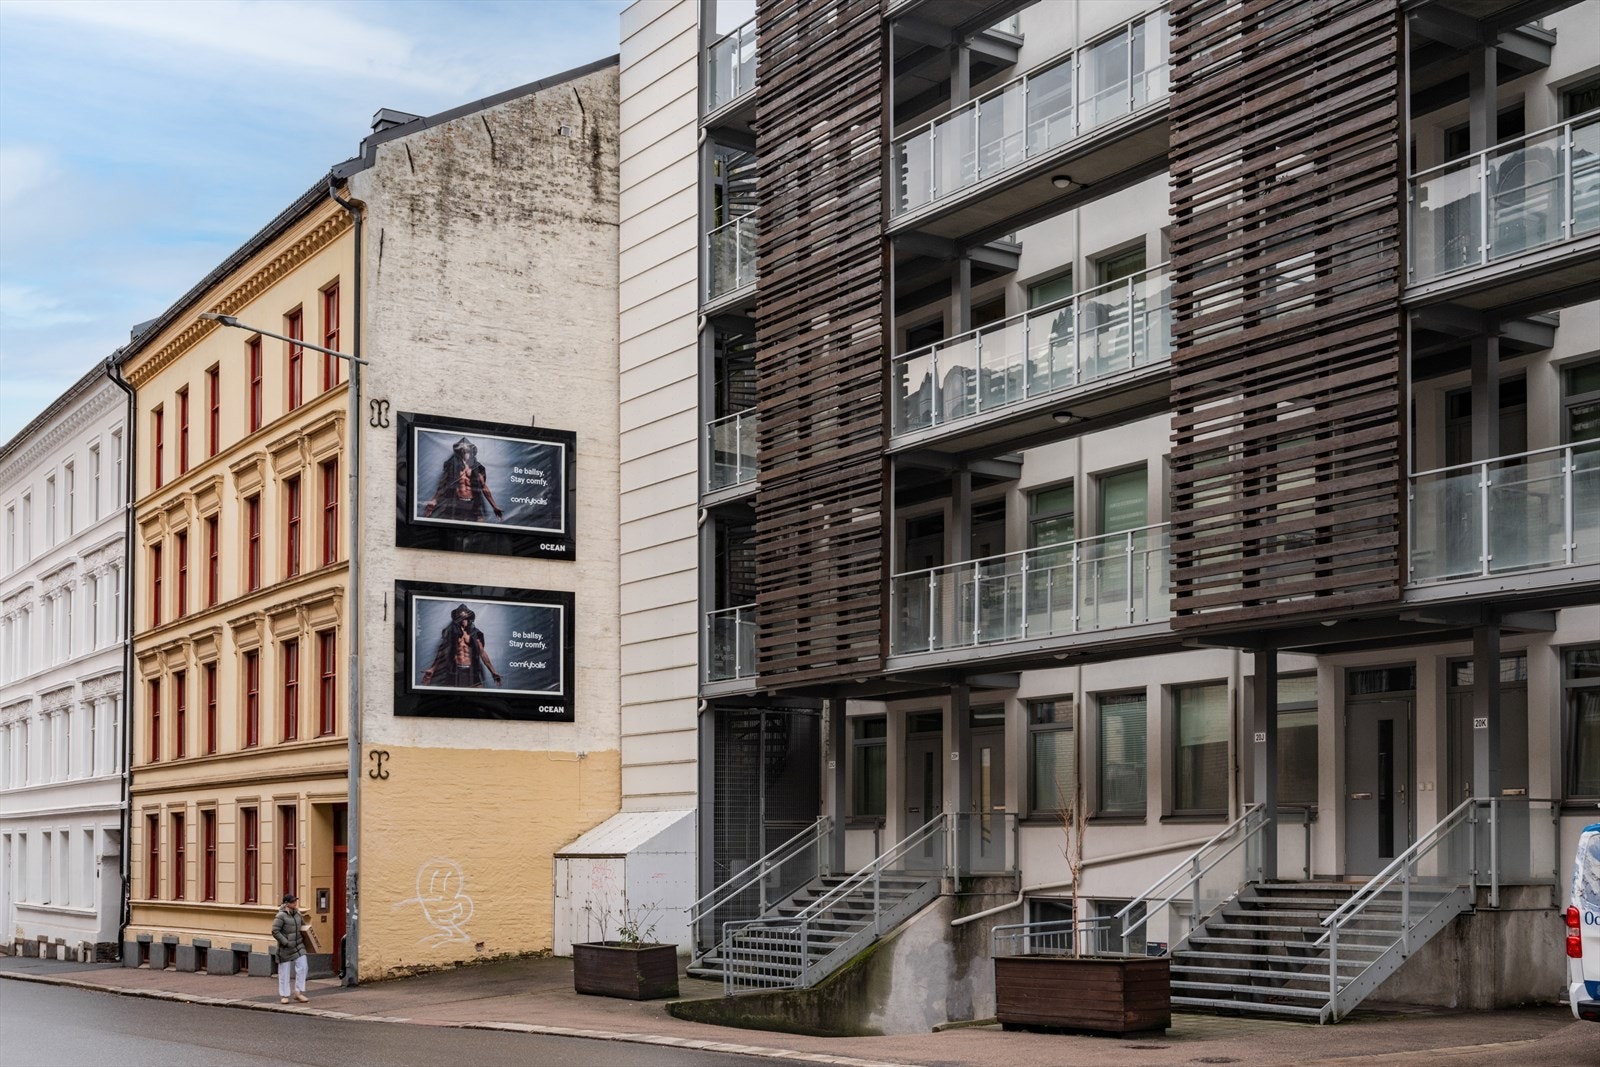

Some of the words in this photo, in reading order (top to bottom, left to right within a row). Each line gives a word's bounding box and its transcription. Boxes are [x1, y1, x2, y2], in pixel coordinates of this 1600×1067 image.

[513, 466, 523, 474] Be
[524, 467, 544, 477] ballsy.
[510, 475, 525, 484] Stay
[526, 478, 548, 487] comfy.
[540, 543, 566, 552] OCEAN
[512, 631, 521, 639] Be
[522, 632, 543, 640] ballsy.
[509, 640, 523, 649] Stay
[525, 641, 547, 650] comfy.
[538, 705, 564, 713] OCEAN
